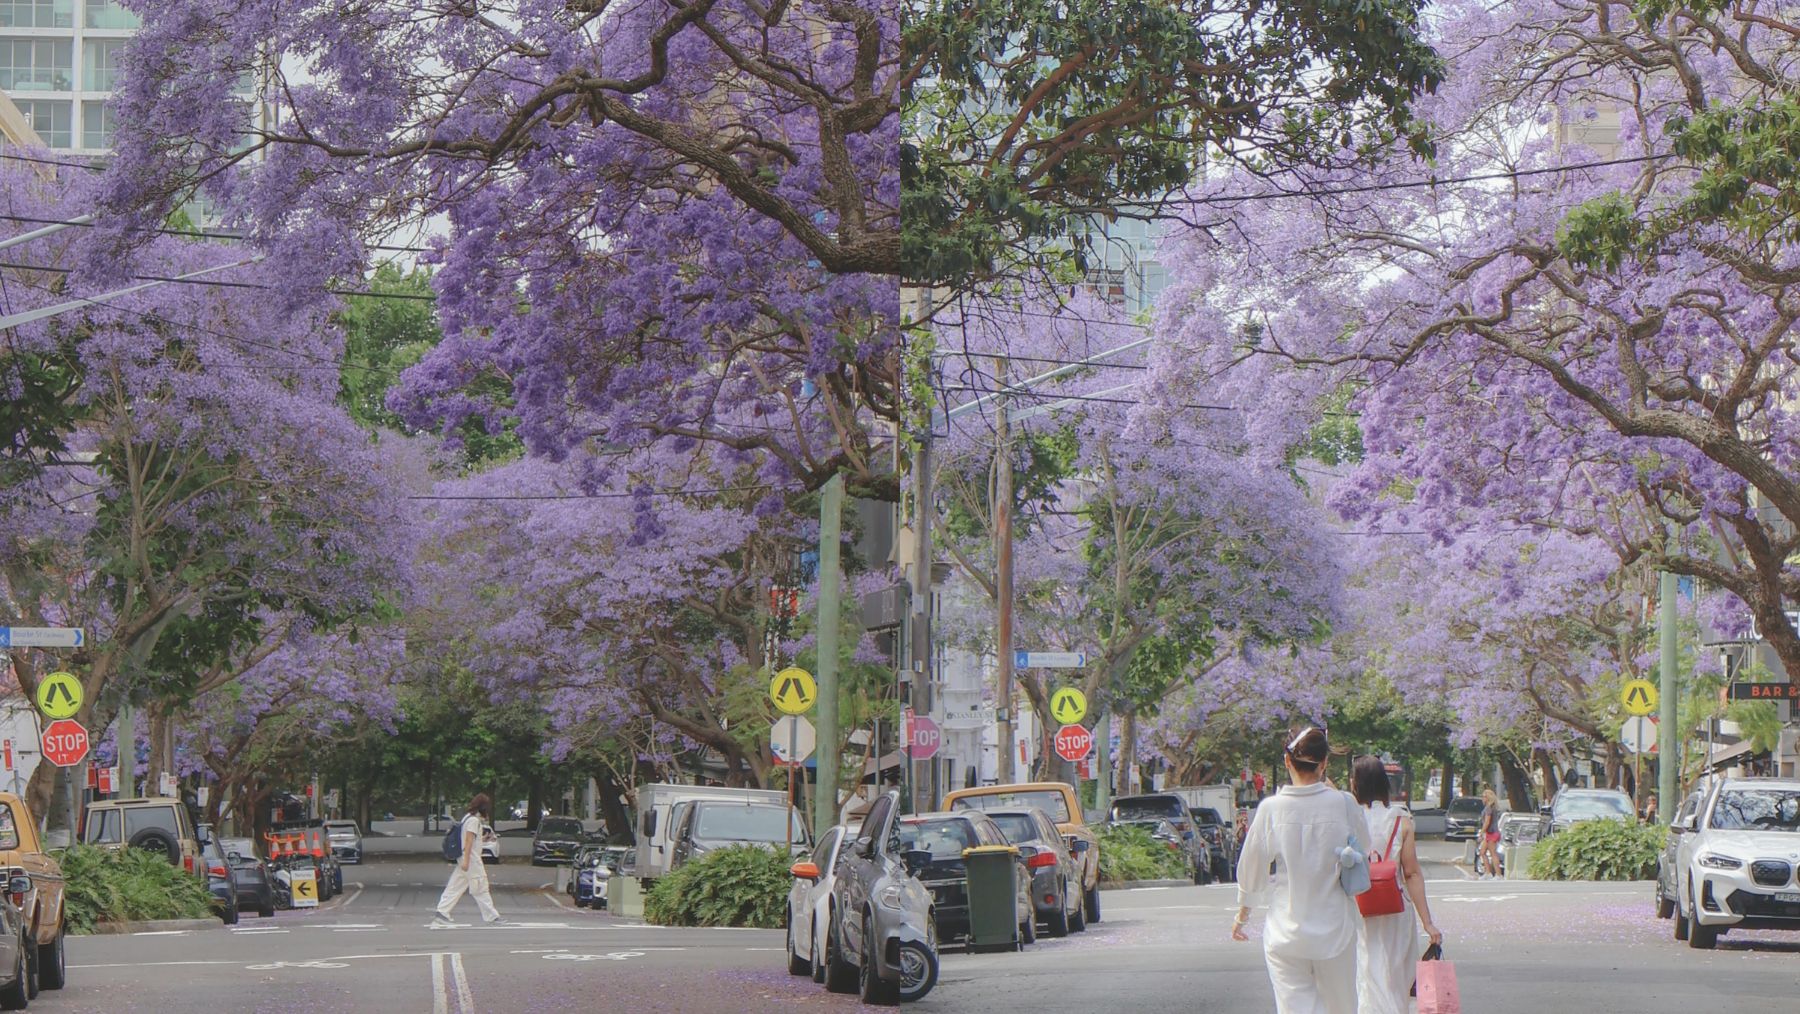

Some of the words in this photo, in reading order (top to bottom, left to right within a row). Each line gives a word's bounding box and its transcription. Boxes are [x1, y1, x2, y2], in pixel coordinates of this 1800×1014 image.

[1751, 686, 1782, 697] BAR
[46, 733, 85, 753] STOP
[913, 730, 939, 746] TOP
[1057, 735, 1089, 751] STOP
